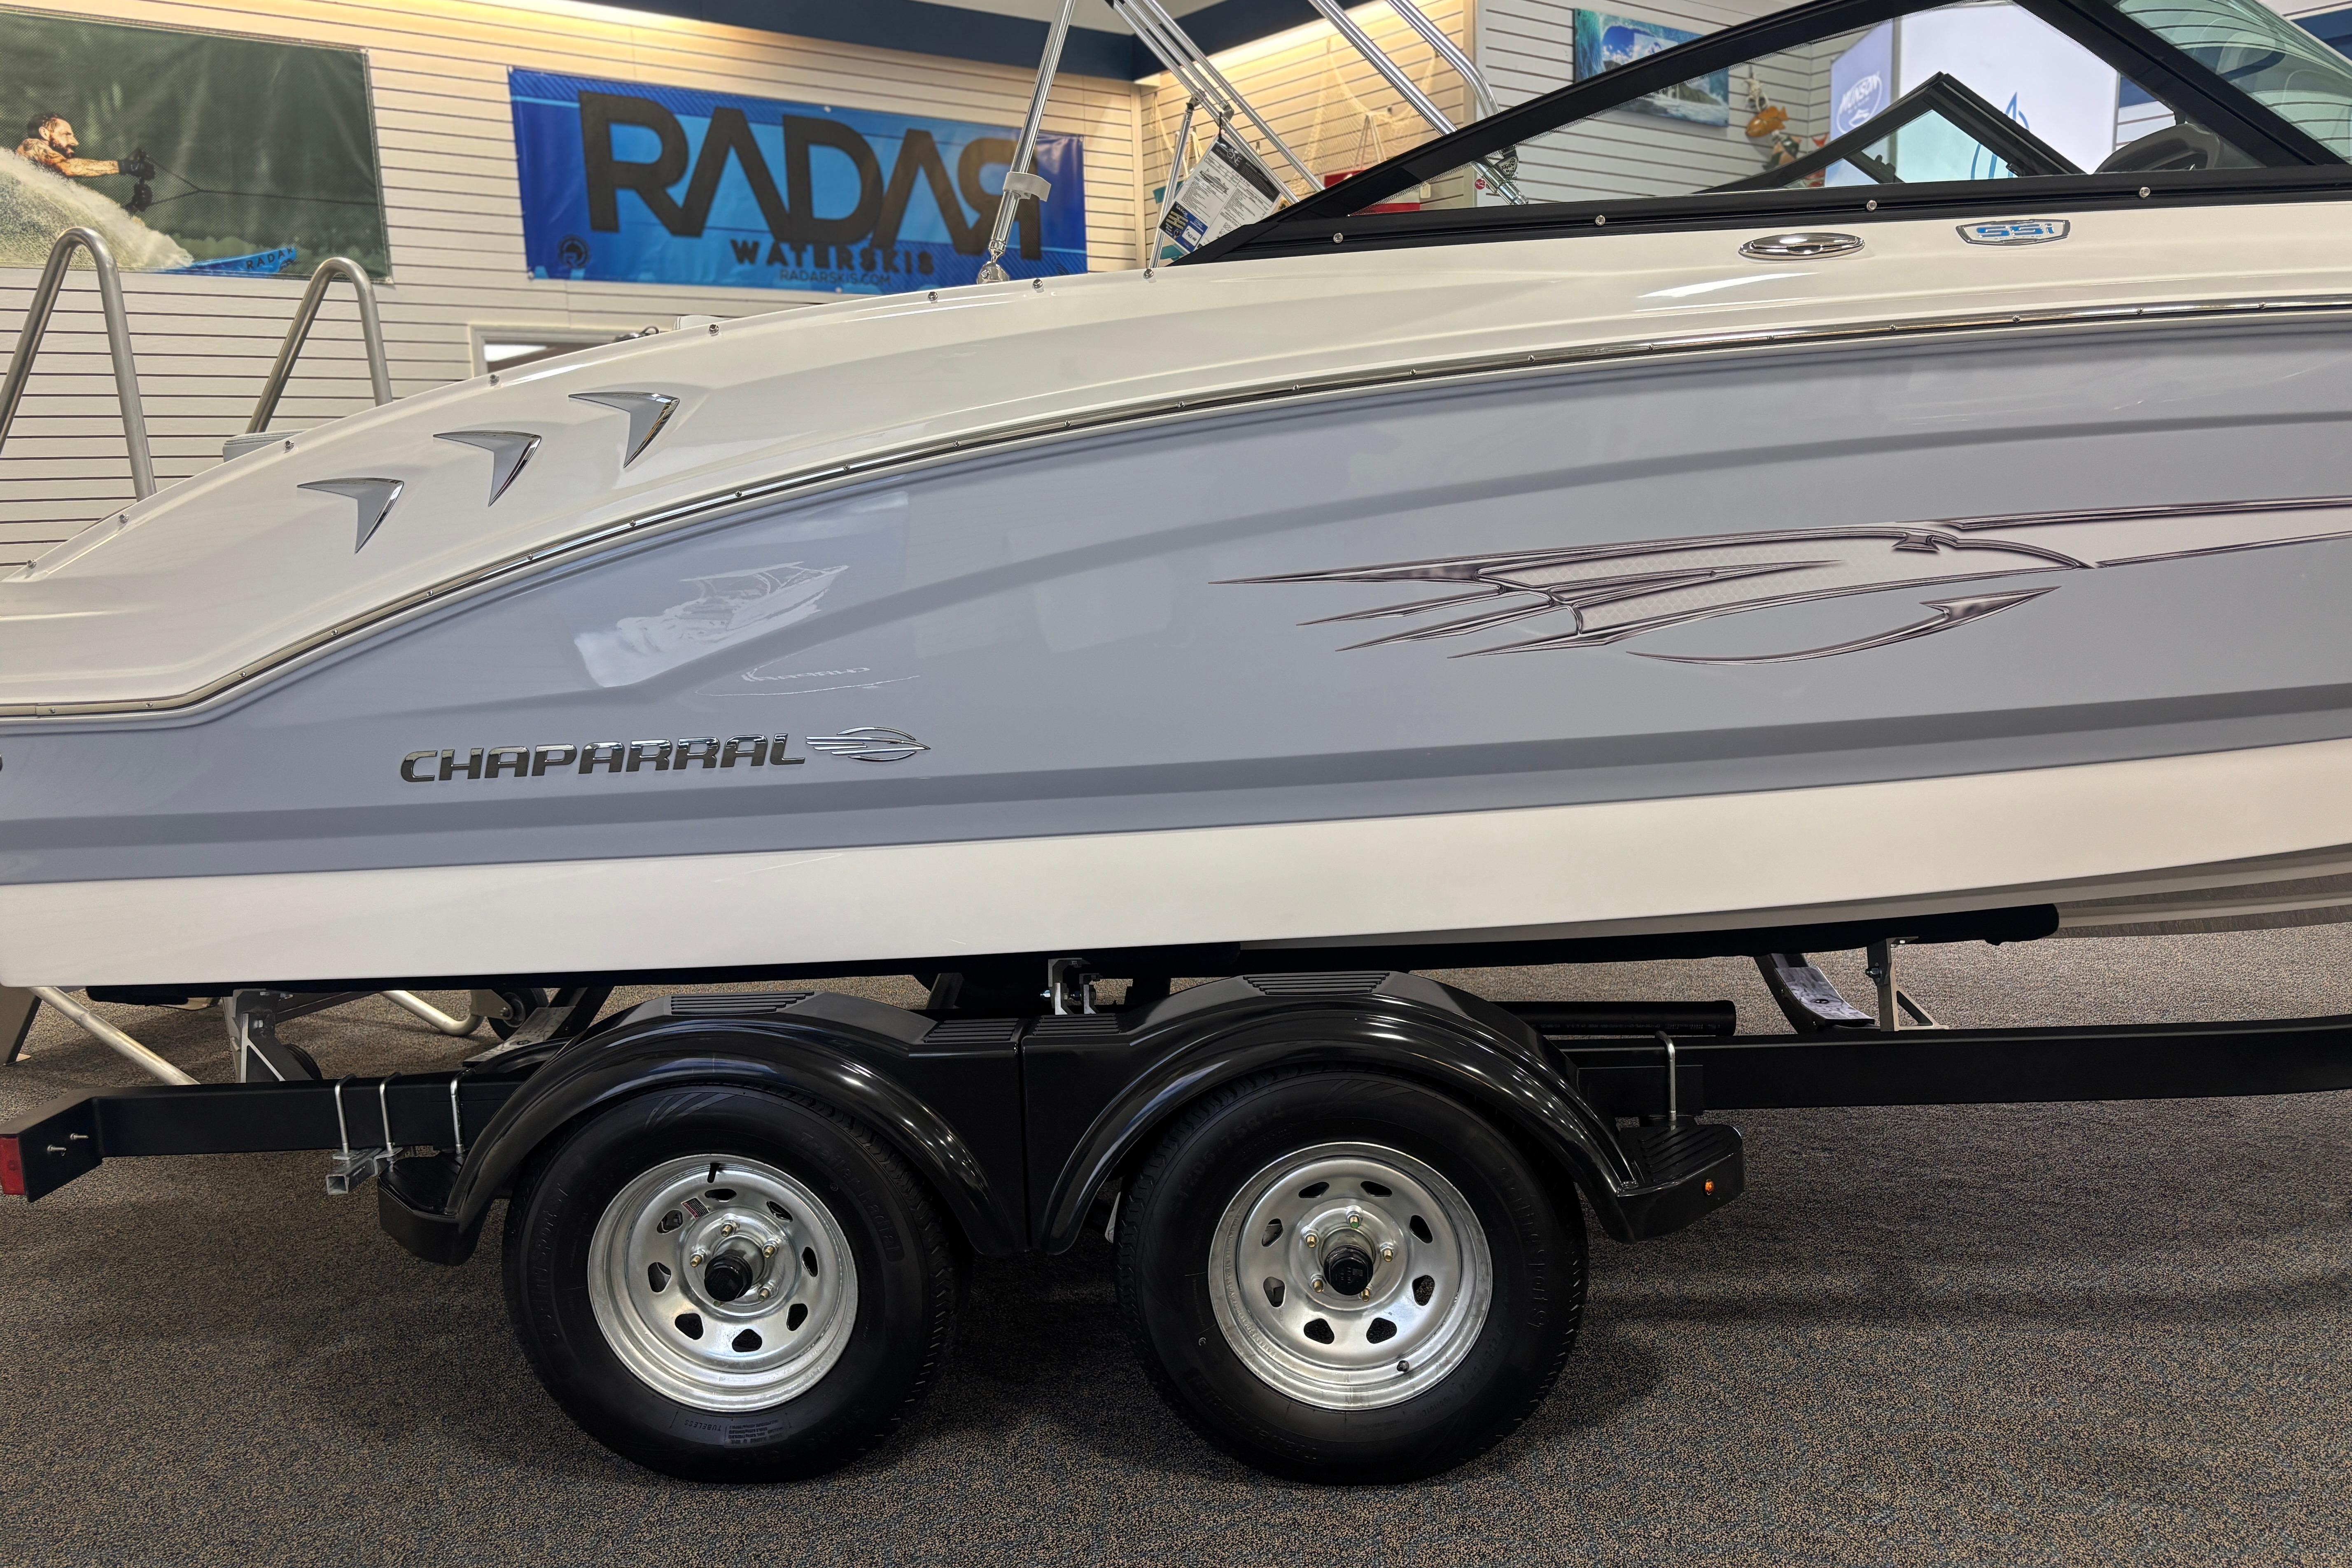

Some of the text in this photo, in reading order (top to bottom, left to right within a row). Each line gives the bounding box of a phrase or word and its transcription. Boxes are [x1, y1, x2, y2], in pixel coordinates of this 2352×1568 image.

[730, 239, 934, 275] WATERSKIS
[779, 269, 891, 285] RADARSKIS.COM
[401, 733, 806, 783] CHAPARRAL
[684, 1419, 721, 1431] TUBELESS
